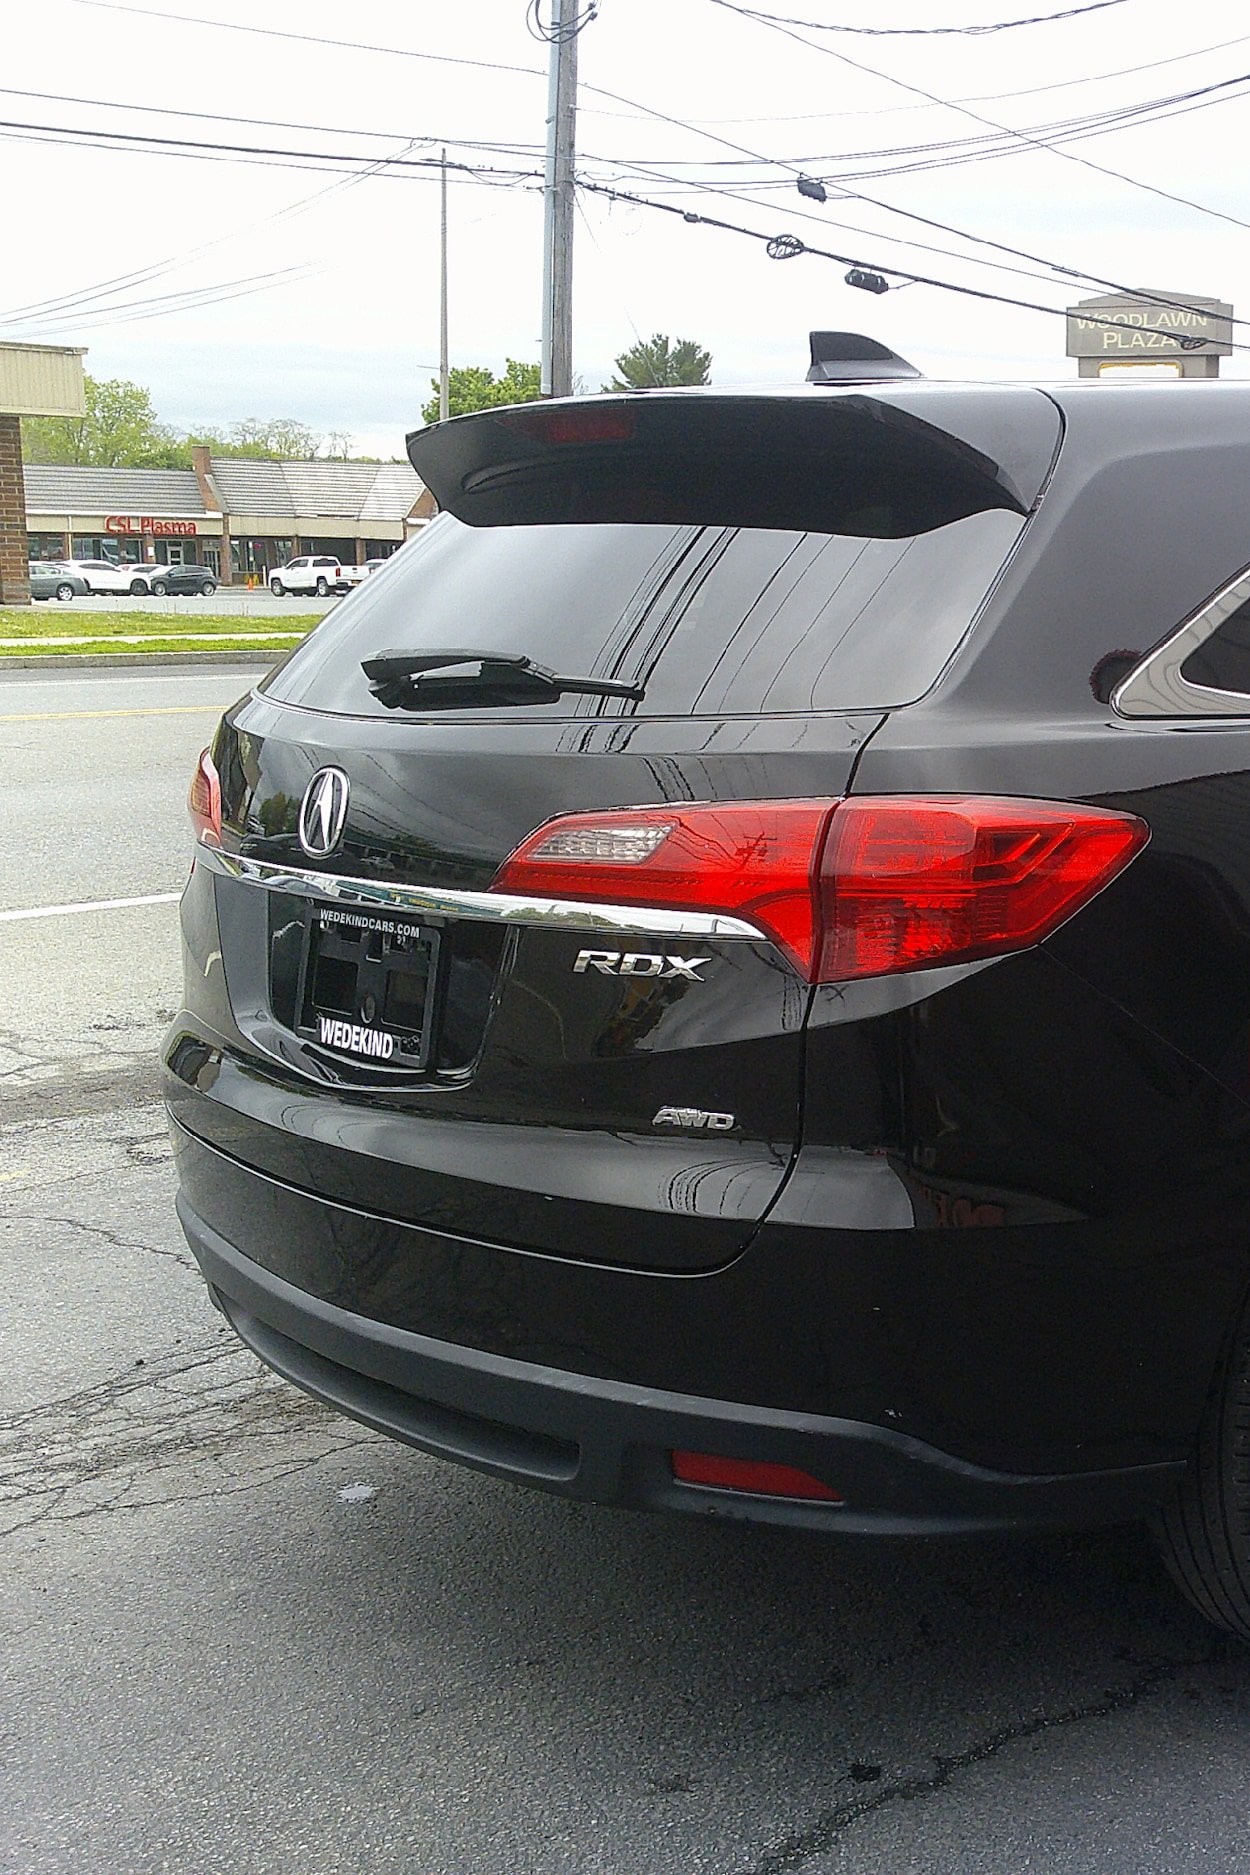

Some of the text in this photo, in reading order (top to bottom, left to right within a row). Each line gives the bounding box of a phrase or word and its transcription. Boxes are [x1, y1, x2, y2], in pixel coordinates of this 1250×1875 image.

[1077, 311, 1208, 329] WOODLAWN
[1103, 332, 1177, 349] PLAZA
[105, 516, 197, 535] CSL Plasma
[320, 908, 420, 939] WEDEKINDCARS.COM
[573, 949, 712, 982] RDX
[320, 1017, 394, 1060] WEDEKIND
[652, 1105, 736, 1131] AWD
